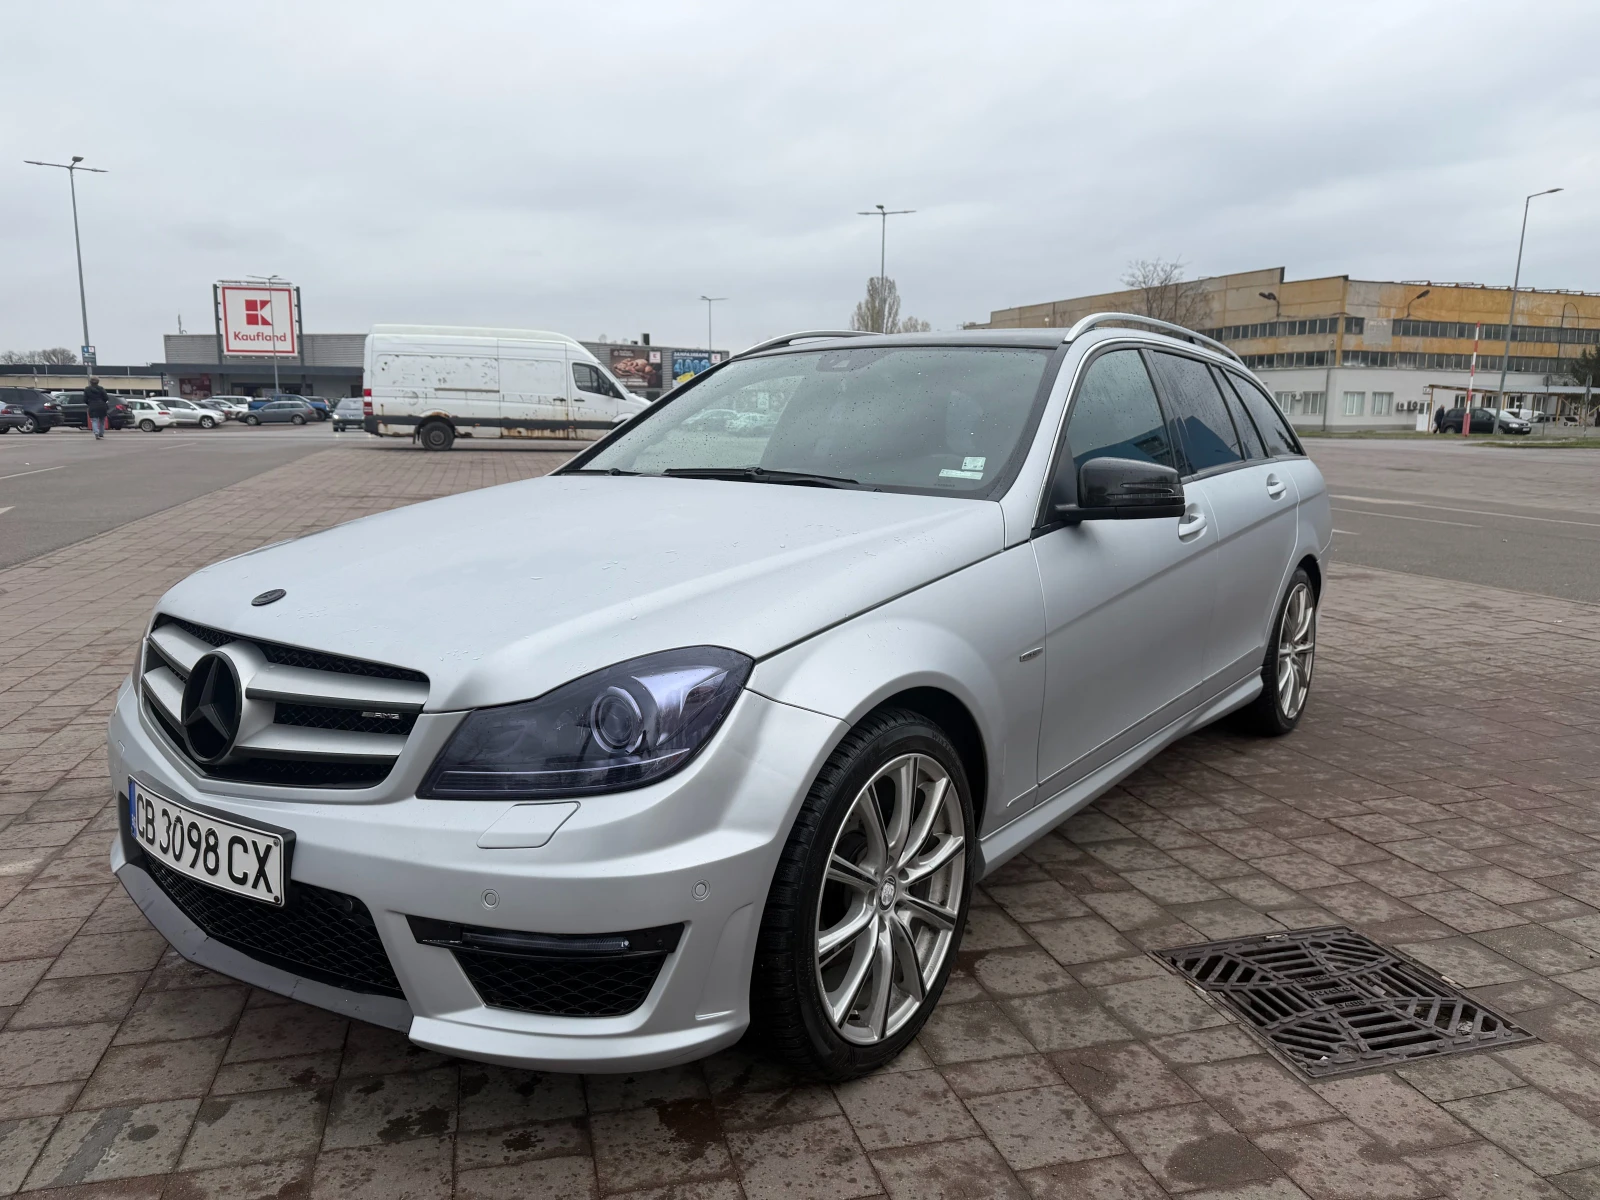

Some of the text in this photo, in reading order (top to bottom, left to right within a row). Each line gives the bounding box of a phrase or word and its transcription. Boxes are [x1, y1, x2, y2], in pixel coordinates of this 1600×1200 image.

[233, 331, 286, 342] Kaufland
[136, 792, 273, 894] CB 3098 CX
